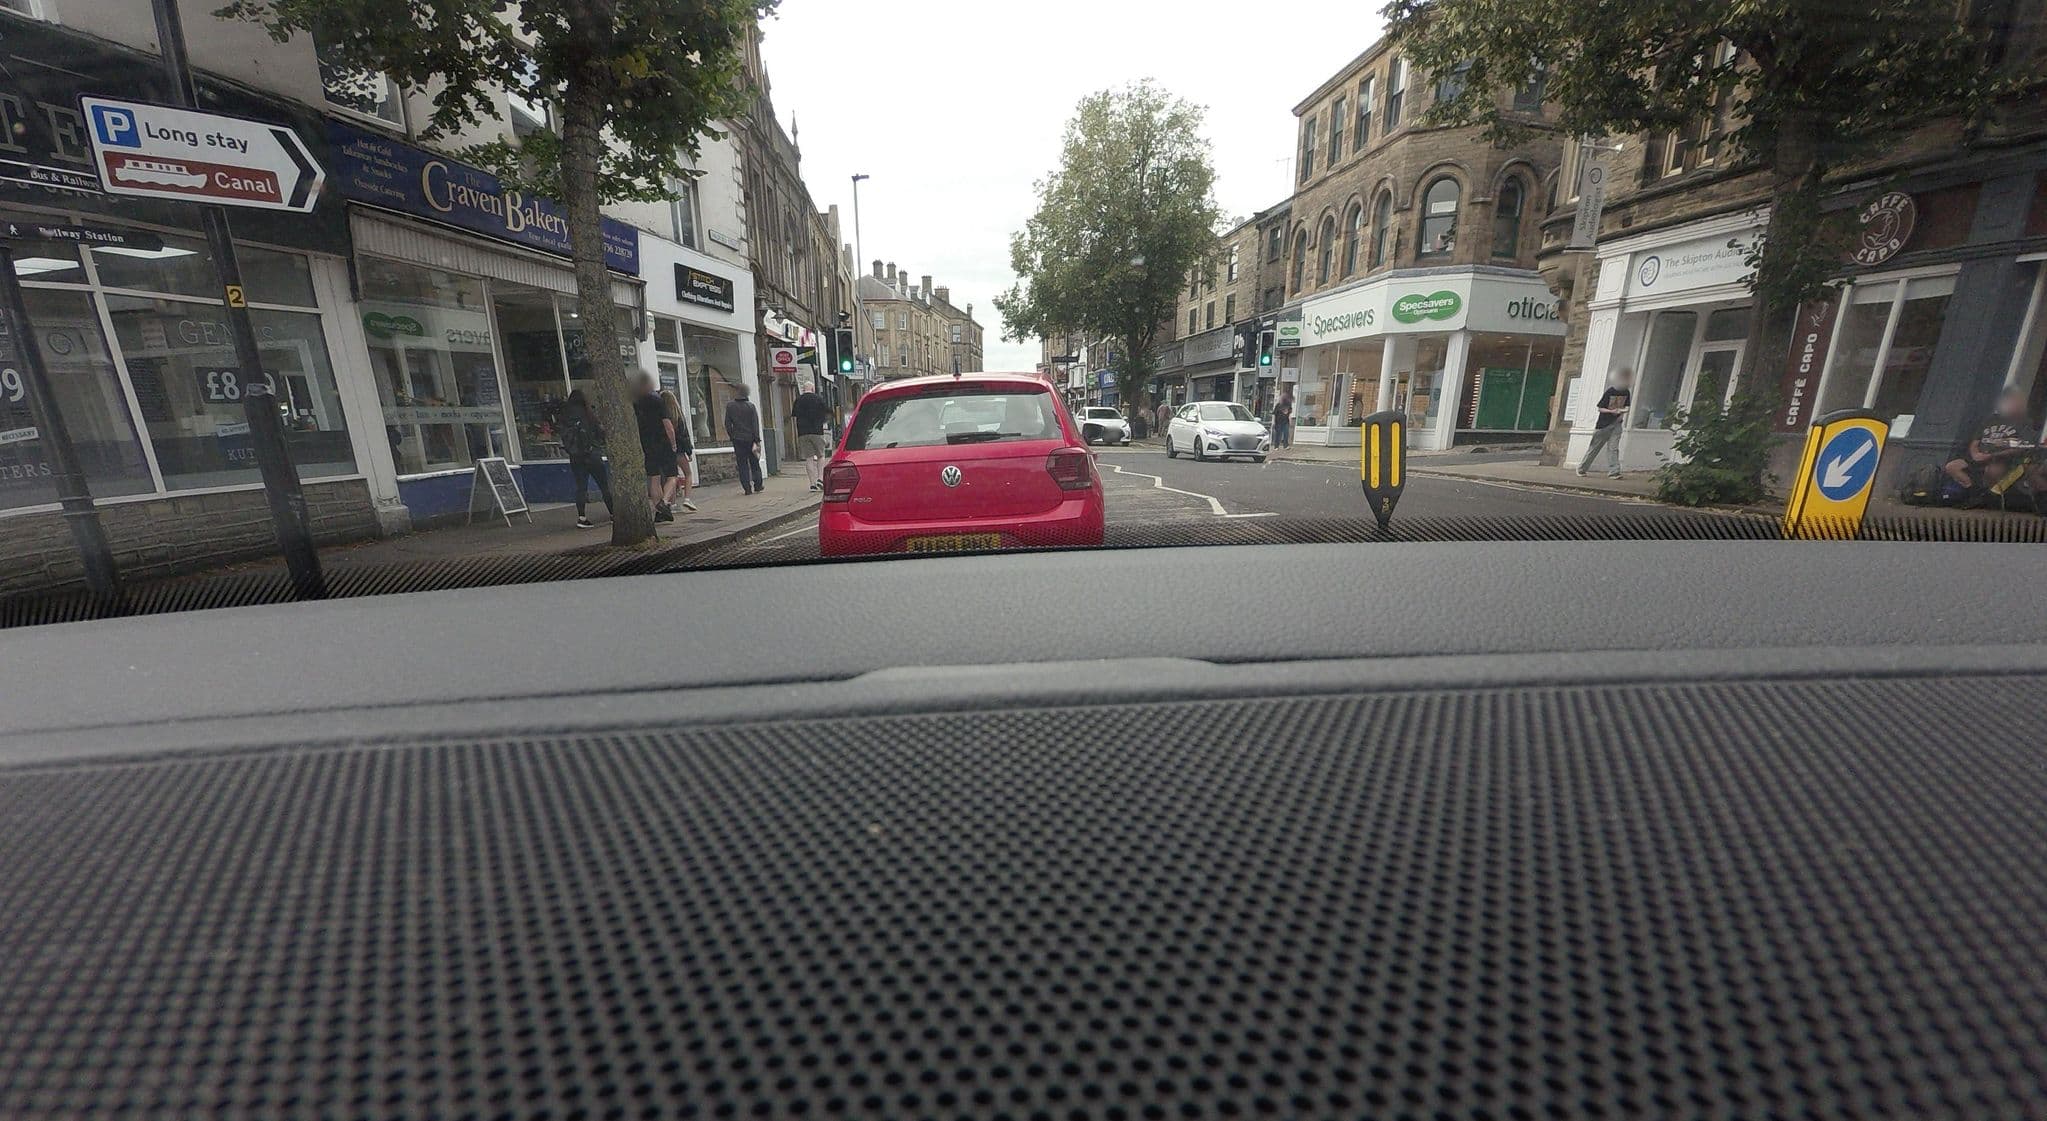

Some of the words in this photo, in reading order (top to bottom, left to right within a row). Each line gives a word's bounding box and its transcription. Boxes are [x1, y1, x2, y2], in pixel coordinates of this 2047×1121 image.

[103, 111, 131, 142] P
[145, 122, 198, 147] Long
[207, 132, 248, 154] stay
[31, 169, 48, 180] Bus
[51, 173, 60, 182] &
[215, 172, 275, 195] Canal
[465, 173, 481, 187] The
[422, 160, 503, 217] Craven
[505, 190, 569, 242] Bakery
[1578, 195, 1592, 230] Skipton
[85, 230, 124, 243] Station
[1665, 258, 1679, 269] The
[1682, 253, 1713, 265] Skipton
[1857, 238, 1901, 262] CAPO
[230, 289, 243, 304] 2
[1399, 298, 1454, 312] Specsavers
[1314, 309, 1374, 339] Specsavers
[1799, 333, 1818, 373] CAPO
